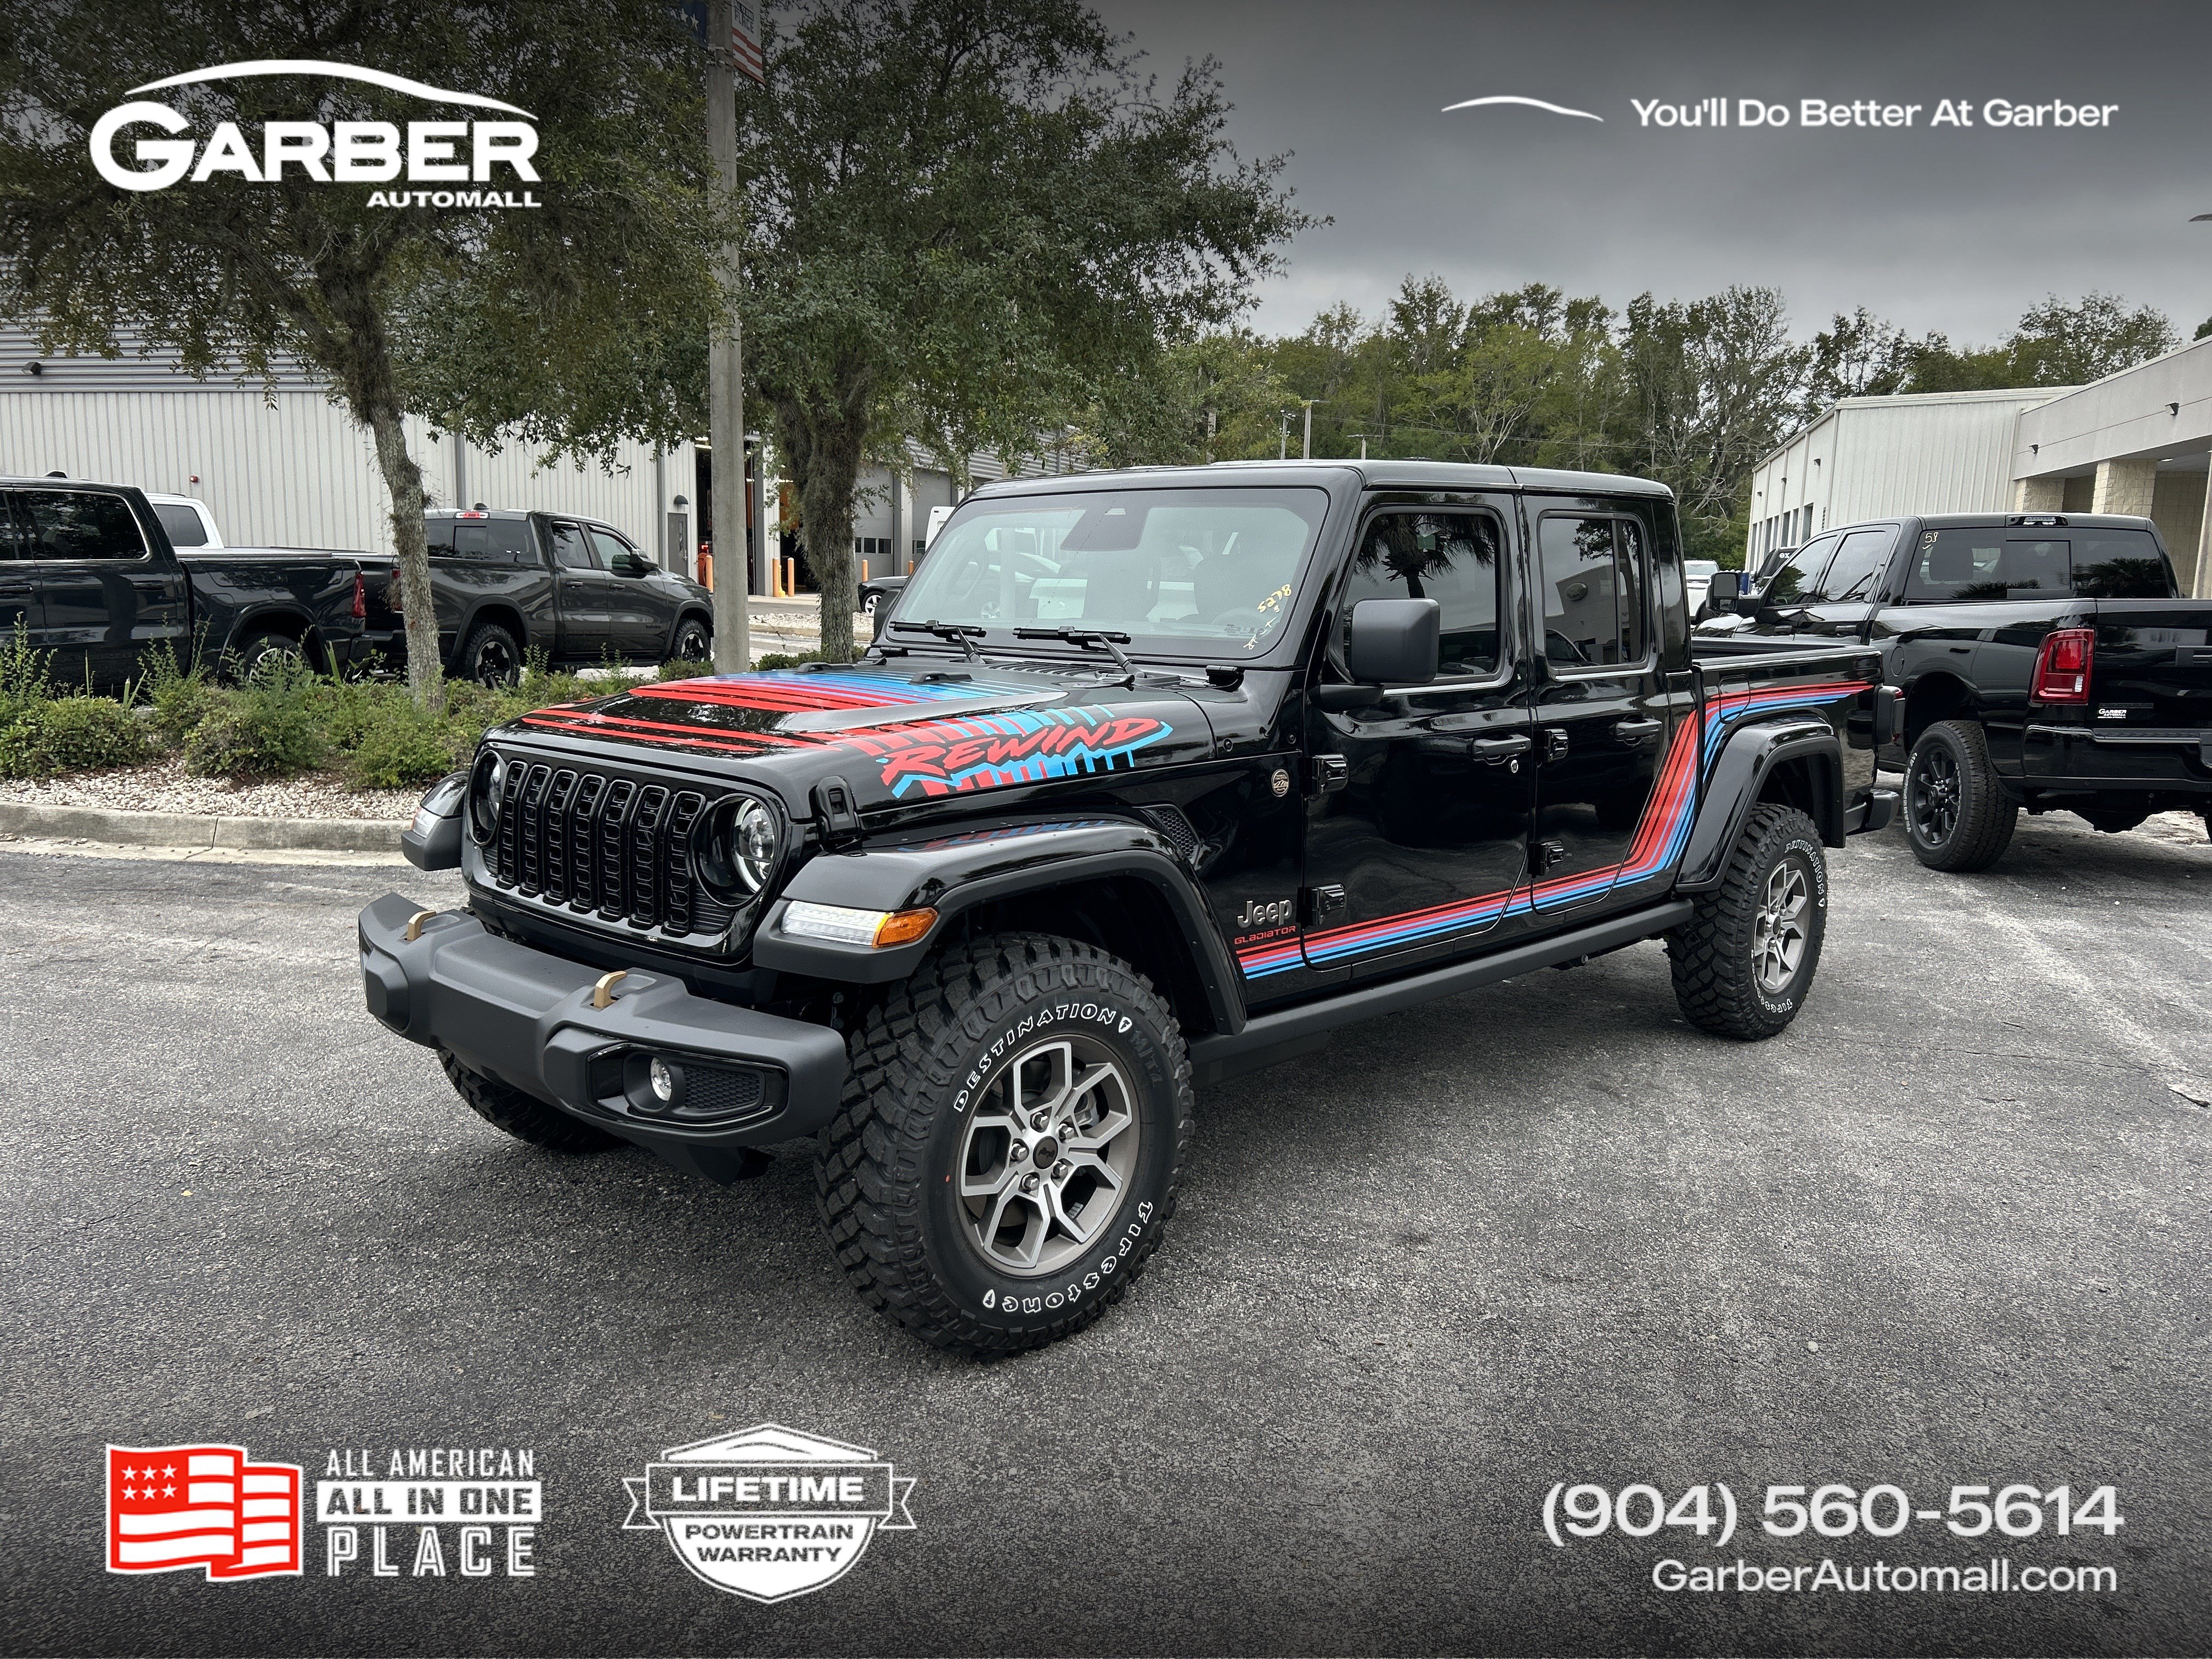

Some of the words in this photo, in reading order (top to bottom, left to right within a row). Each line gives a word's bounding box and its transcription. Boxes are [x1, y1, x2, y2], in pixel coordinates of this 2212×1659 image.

[735, 7, 754, 33] PLACE
[881, 718, 1160, 786] REWIND
[1785, 839, 1824, 895] DESTINATION
[1237, 900, 1293, 928] Jeep
[1234, 926, 1296, 945] GLADIATOR
[953, 1003, 1116, 1112] DESTINATION
